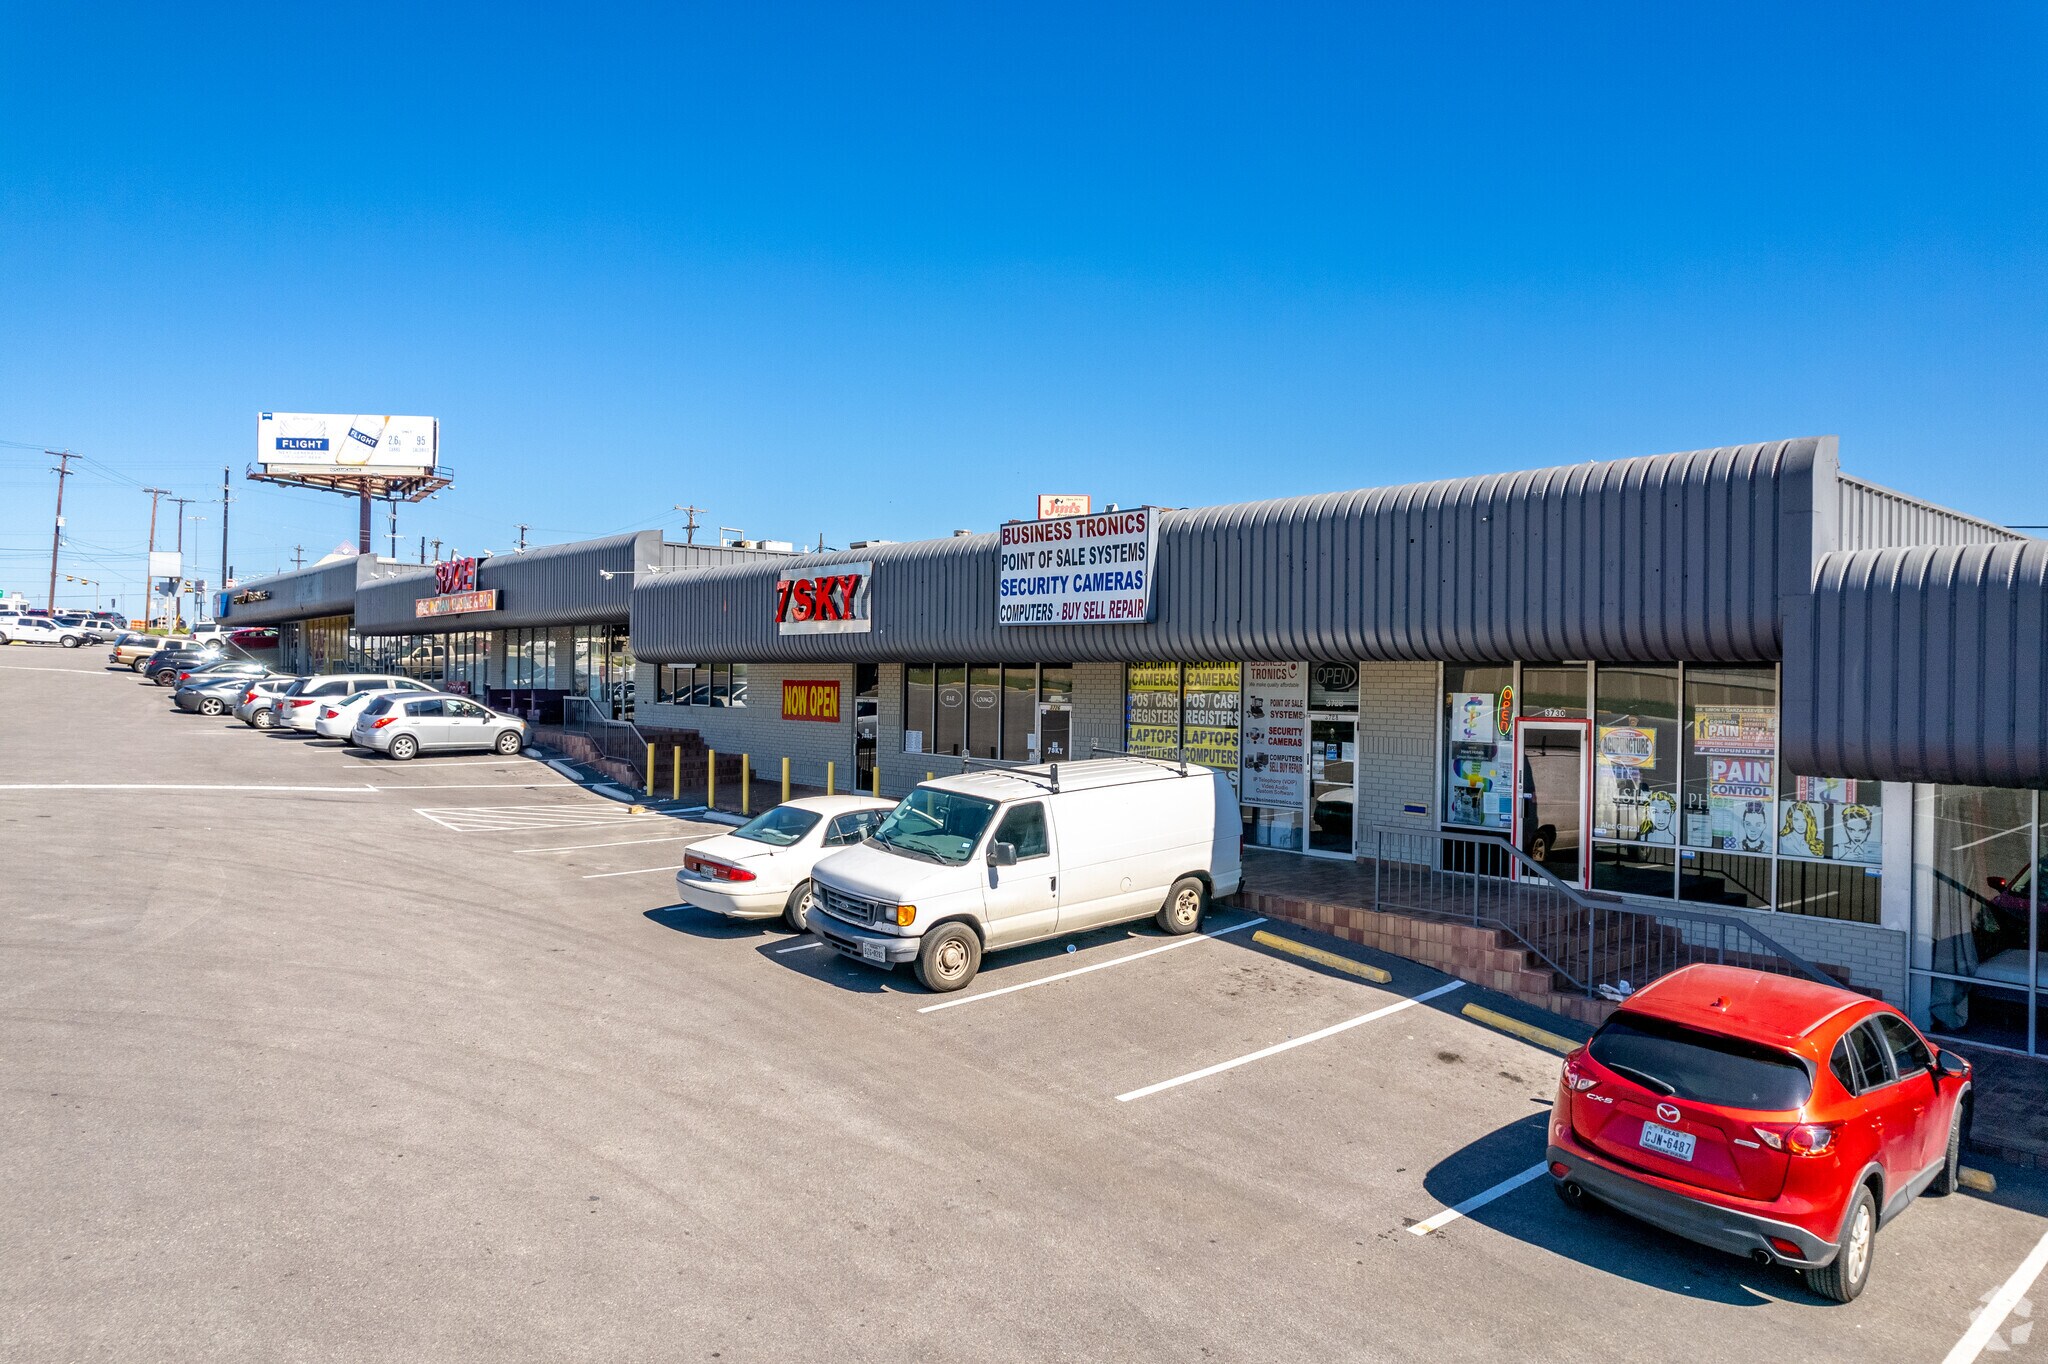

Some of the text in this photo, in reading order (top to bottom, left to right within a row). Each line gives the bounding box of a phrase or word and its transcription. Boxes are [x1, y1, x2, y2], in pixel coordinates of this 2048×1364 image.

[282, 439, 323, 449] FLIGHT
[350, 430, 376, 446] FLIGHT
[416, 435, 426, 446] 95
[1045, 499, 1081, 516] Jim's
[1002, 513, 1146, 546] BUSINESS TRONICS
[1001, 541, 1146, 571] POINT OF SALE SYSTEMS
[1000, 570, 1143, 597] SECURITY CAMERAS
[479, 593, 492, 608] BAR
[1000, 603, 1054, 622] COMPUTERS
[1061, 602, 1082, 620] BUY
[1083, 600, 1106, 620] SELL
[1108, 598, 1144, 619] REPAIR
[1132, 662, 1179, 671] SECURITY
[1187, 662, 1239, 671] SECURITY
[1132, 673, 1179, 687] CAMERAS
[1187, 673, 1240, 687] CAMERAS
[1250, 668, 1287, 680] TRONICS
[1316, 667, 1350, 685] OPEN
[784, 685, 838, 718] NOW OPEN
[1131, 693, 1149, 708] POS
[1155, 693, 1179, 708] CASH
[1186, 693, 1206, 708] POS
[1213, 693, 1239, 709] CASH
[1270, 699, 1303, 708] POINT OF SALE
[1130, 709, 1179, 724] REGISTERS
[1185, 709, 1239, 726] REGISTERS
[1270, 710, 1304, 719] SYSTEMS
[1545, 709, 1565, 717] 3730
[1129, 728, 1178, 744] LAPTOPS
[1268, 727, 1303, 736] SECURITY
[1708, 724, 1739, 737] PAIN
[1185, 730, 1239, 747] LAPTOPS
[1268, 737, 1303, 747] CAMERAS
[1185, 746, 1239, 765] COMPUTERS
[1269, 754, 1303, 762] COMPUTERS
[1269, 762, 1303, 774] SELL BUY REPAIR
[1712, 760, 1771, 784] PAIN
[1258, 777, 1281, 785] Telephony
[1711, 785, 1769, 797] CONTROL
[1244, 796, 1303, 806] www.businesstronics.com
[1660, 1127, 1680, 1138] TEXAS
[1644, 1130, 1691, 1155] CJN-6487
